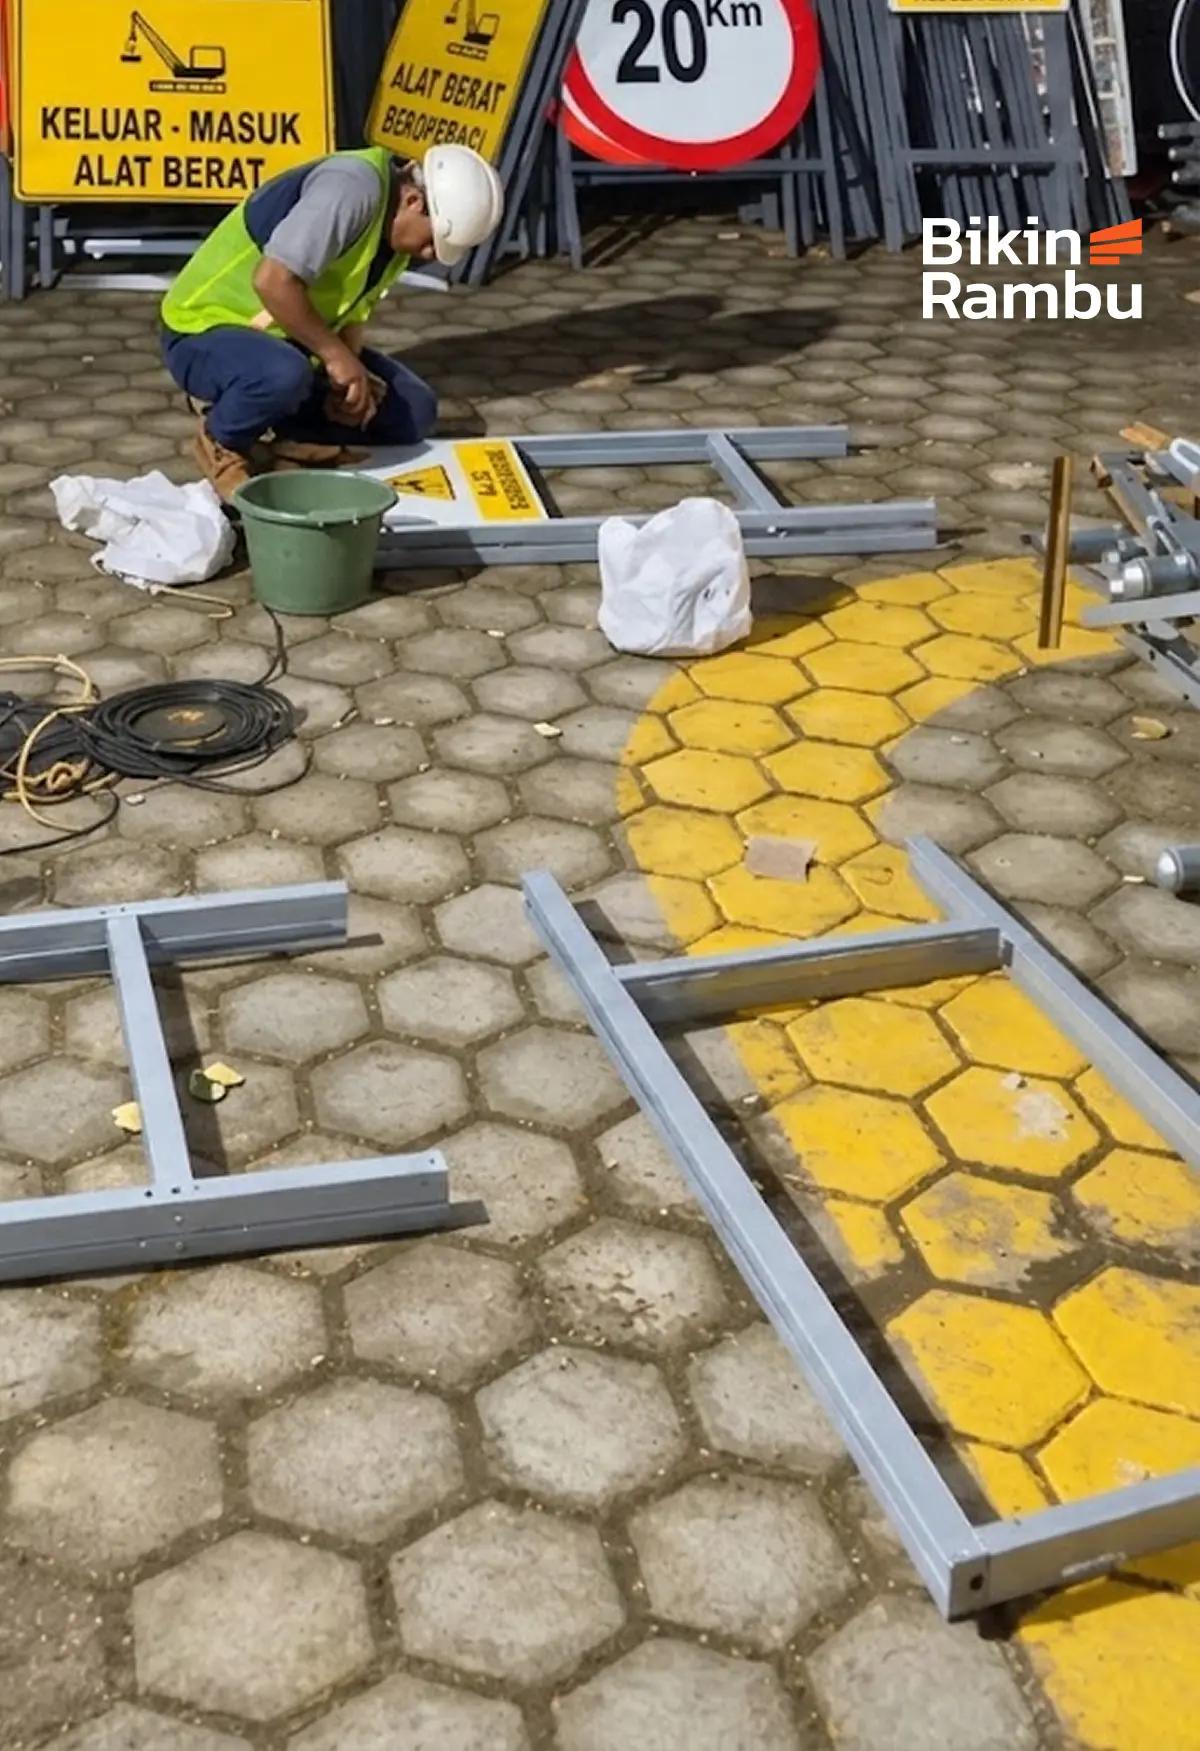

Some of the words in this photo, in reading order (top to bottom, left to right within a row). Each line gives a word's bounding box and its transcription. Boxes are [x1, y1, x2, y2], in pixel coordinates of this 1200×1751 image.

[612, 0, 707, 83] 20
[706, 0, 762, 27] Km
[390, 63, 442, 99] ALAT
[440, 72, 507, 115] BERAT
[41, 107, 162, 141] KELUAR
[190, 110, 301, 145] MASUK
[74, 155, 151, 187] ALAT
[163, 156, 265, 189] BERAT
